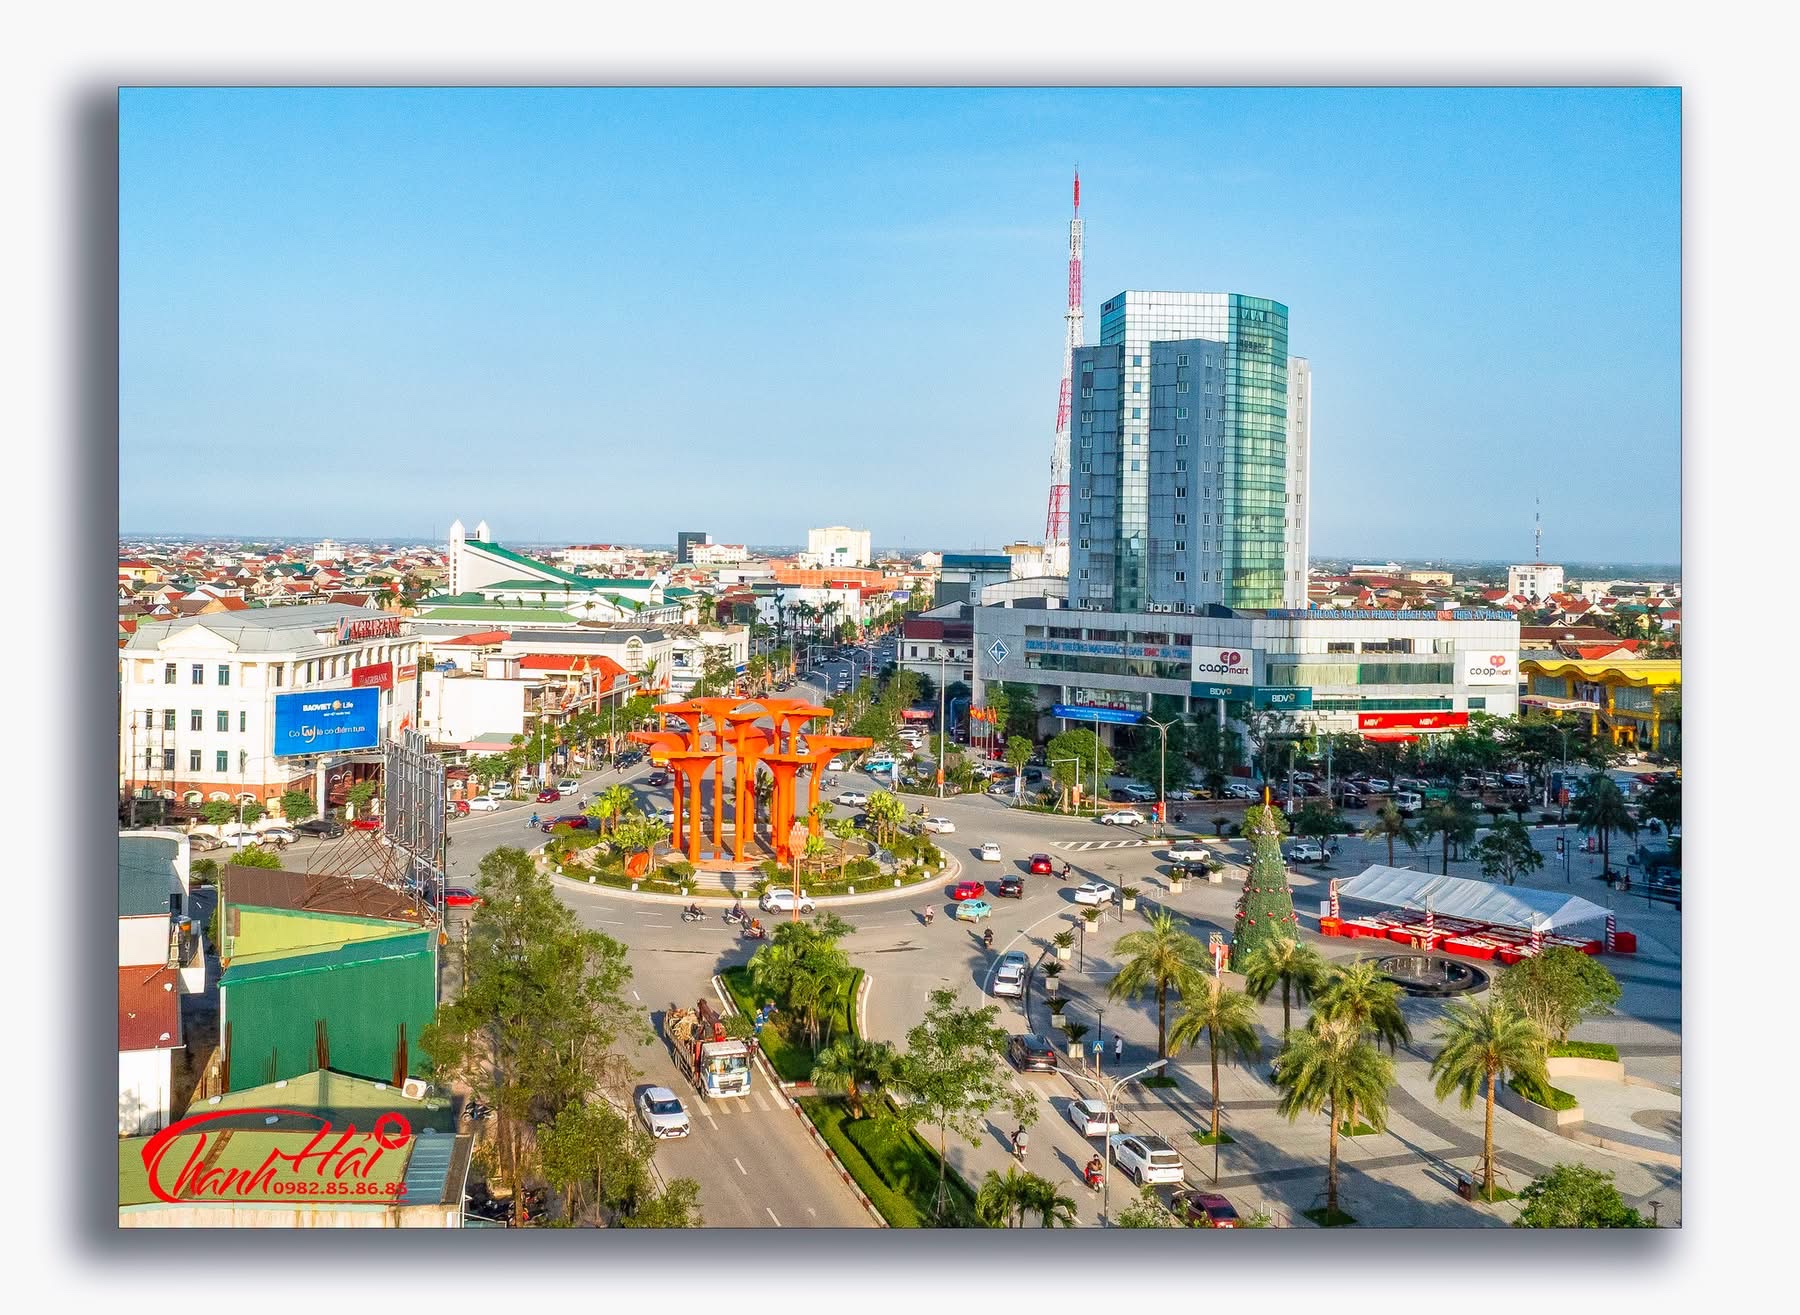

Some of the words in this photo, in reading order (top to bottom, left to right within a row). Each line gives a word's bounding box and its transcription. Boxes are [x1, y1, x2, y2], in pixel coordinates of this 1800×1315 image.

[1209, 688, 1226, 696] BIDV
[1271, 694, 1288, 703] BIDV
[343, 700, 354, 709] Life
